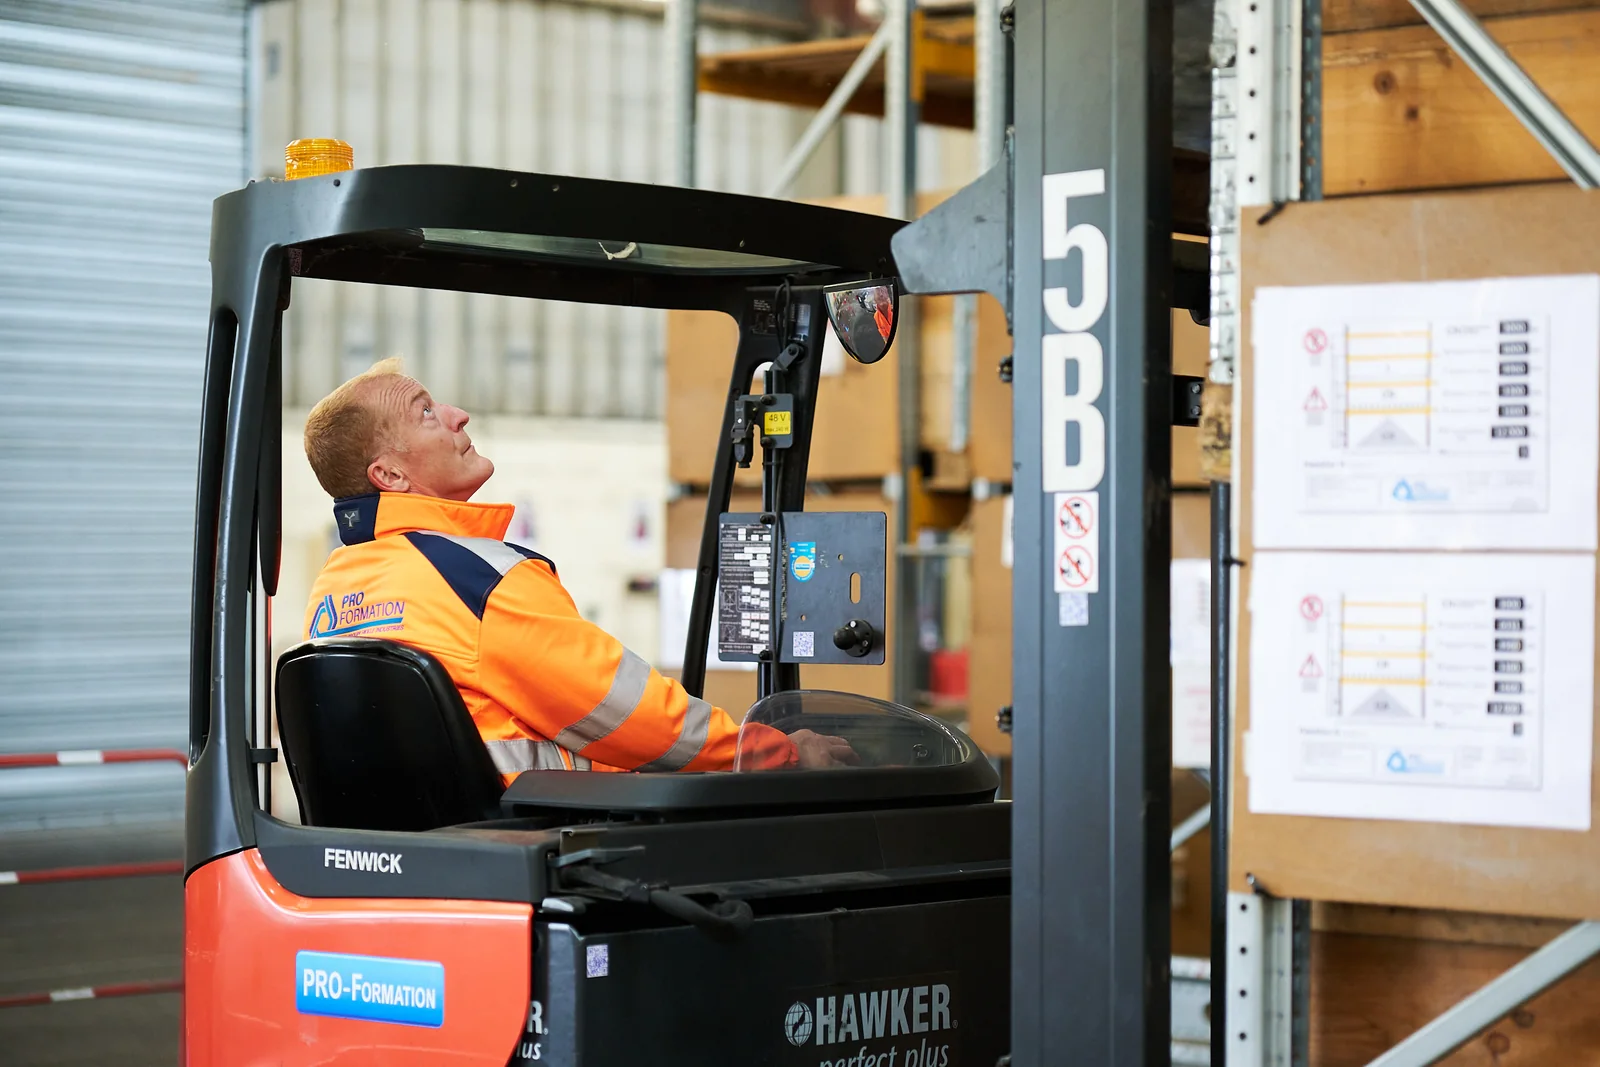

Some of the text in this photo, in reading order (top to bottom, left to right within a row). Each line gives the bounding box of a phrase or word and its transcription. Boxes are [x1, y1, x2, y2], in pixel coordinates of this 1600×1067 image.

[340, 601, 404, 624] FORMATION
[342, 592, 364, 608] PRO
[324, 848, 402, 874] FENWICK
[815, 984, 951, 1046] HAWKER
[904, 1038, 949, 1067] plus
